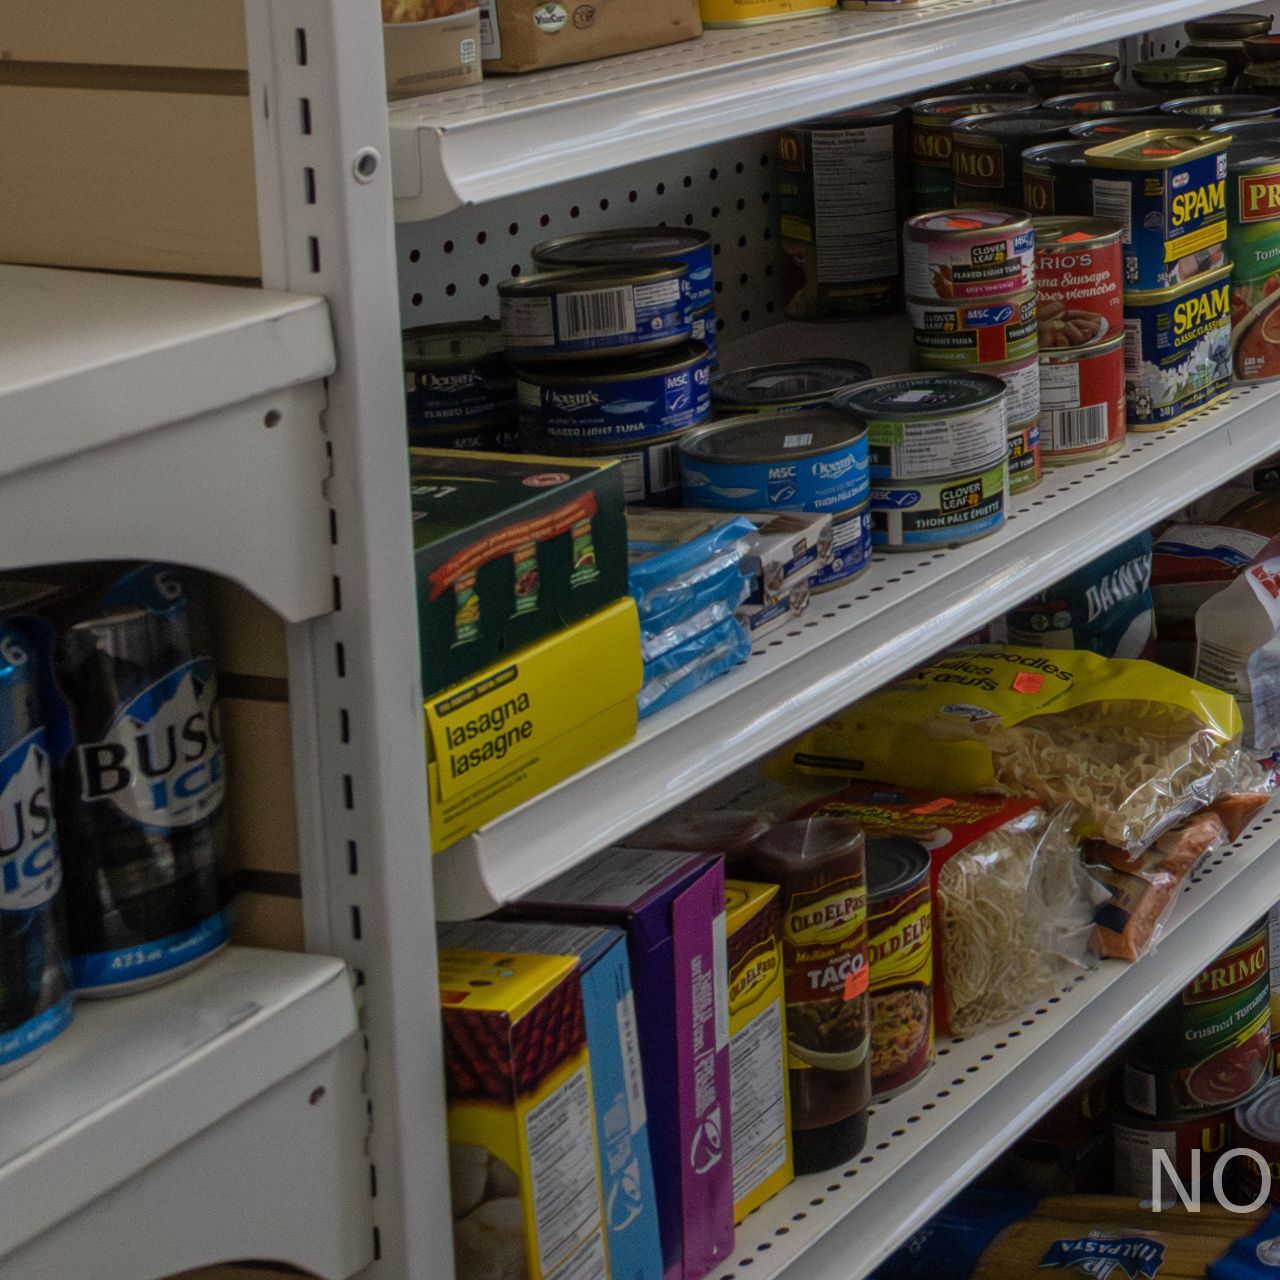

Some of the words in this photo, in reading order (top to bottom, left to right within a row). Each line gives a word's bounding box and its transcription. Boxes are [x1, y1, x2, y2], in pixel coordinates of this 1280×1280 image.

[1172, 179, 1226, 227] SPAM
[972, 242, 1006, 258] CLOVER
[973, 252, 994, 264] LEAF
[1061, 269, 1111, 290] Sausages
[966, 307, 990, 321] MSC
[1173, 285, 1230, 335] SPAM
[768, 465, 797, 478] MSC
[942, 482, 982, 500] CLOVER
[943, 495, 967, 510] LEAF
[916, 515, 946, 530] THON
[1086, 551, 1152, 623] DAINTY
[975, 647, 1074, 683] noodles
[445, 688, 531, 750] lasagna
[86, 705, 221, 798] BUS
[450, 716, 535, 779] lasagne
[790, 907, 822, 934] OLD
[824, 903, 842, 926] EL
[867, 935, 901, 968] OLD
[807, 954, 865, 992] TACO
[1191, 945, 1267, 995] PRIMO
[1185, 1009, 1234, 1041] Crushed
